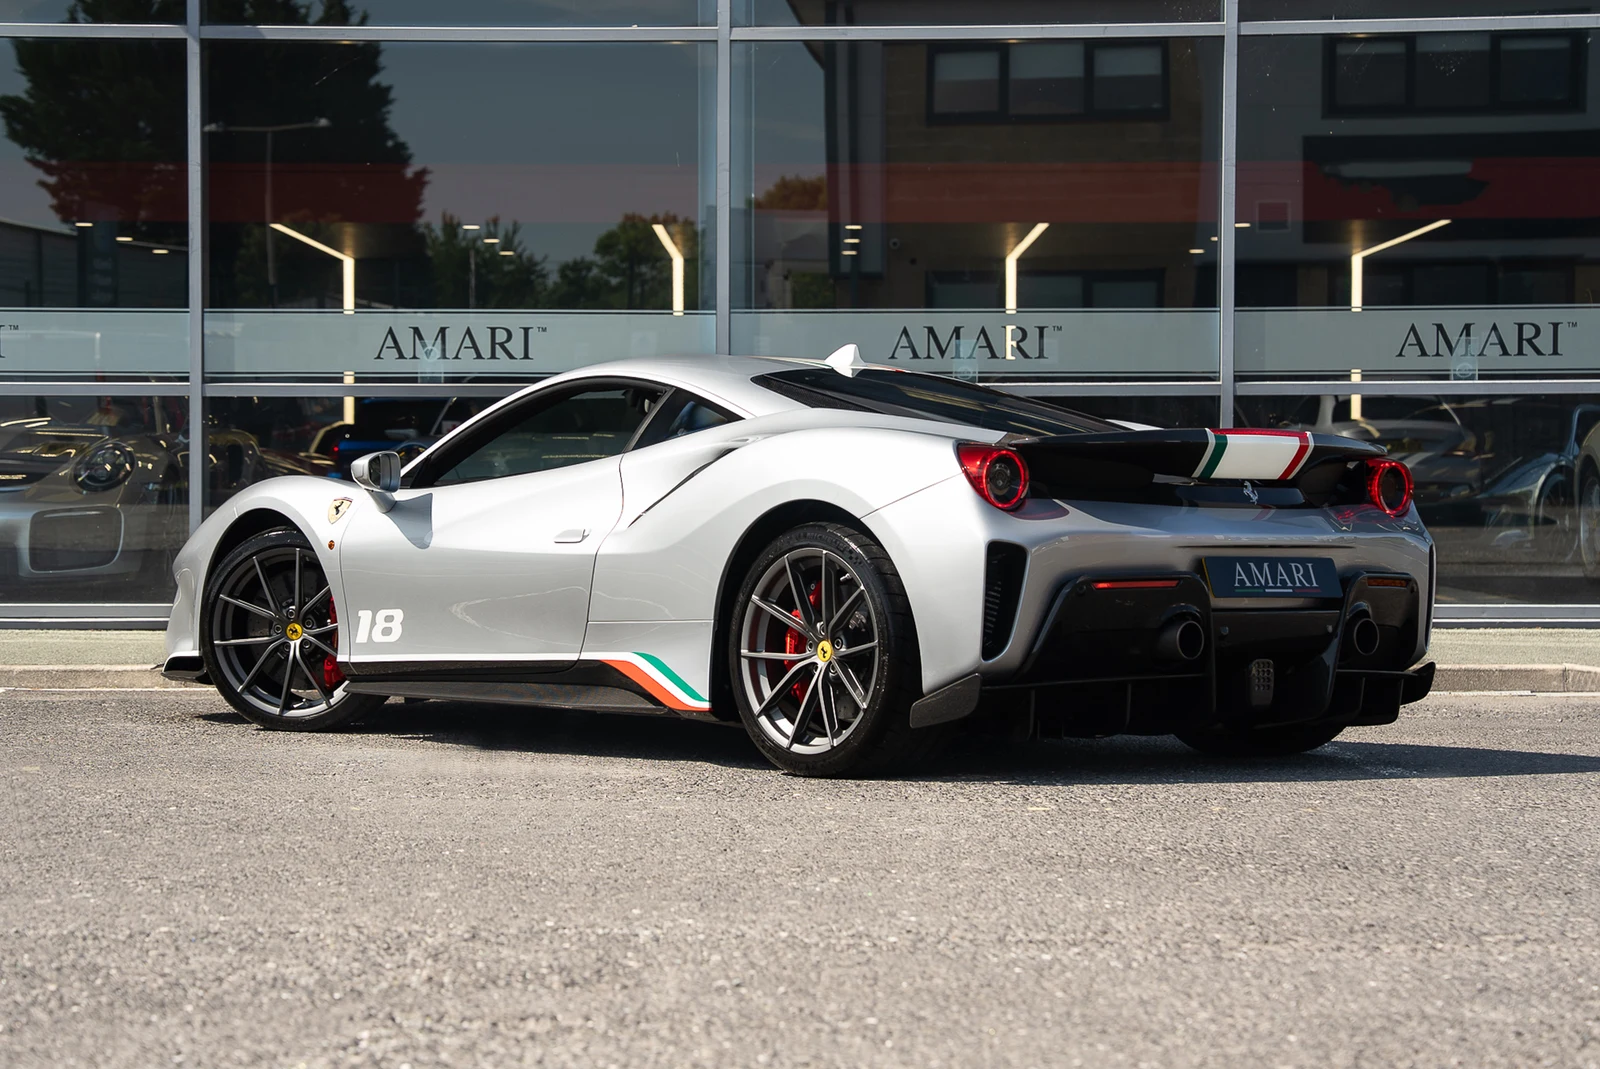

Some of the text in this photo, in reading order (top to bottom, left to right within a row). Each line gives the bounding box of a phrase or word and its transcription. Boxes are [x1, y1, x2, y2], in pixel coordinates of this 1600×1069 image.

[374, 325, 534, 360] AMARI
[888, 325, 1049, 360] AMARI
[1395, 322, 1564, 357] AMARI
[1234, 562, 1319, 587] AMARI
[355, 608, 404, 643] 18
